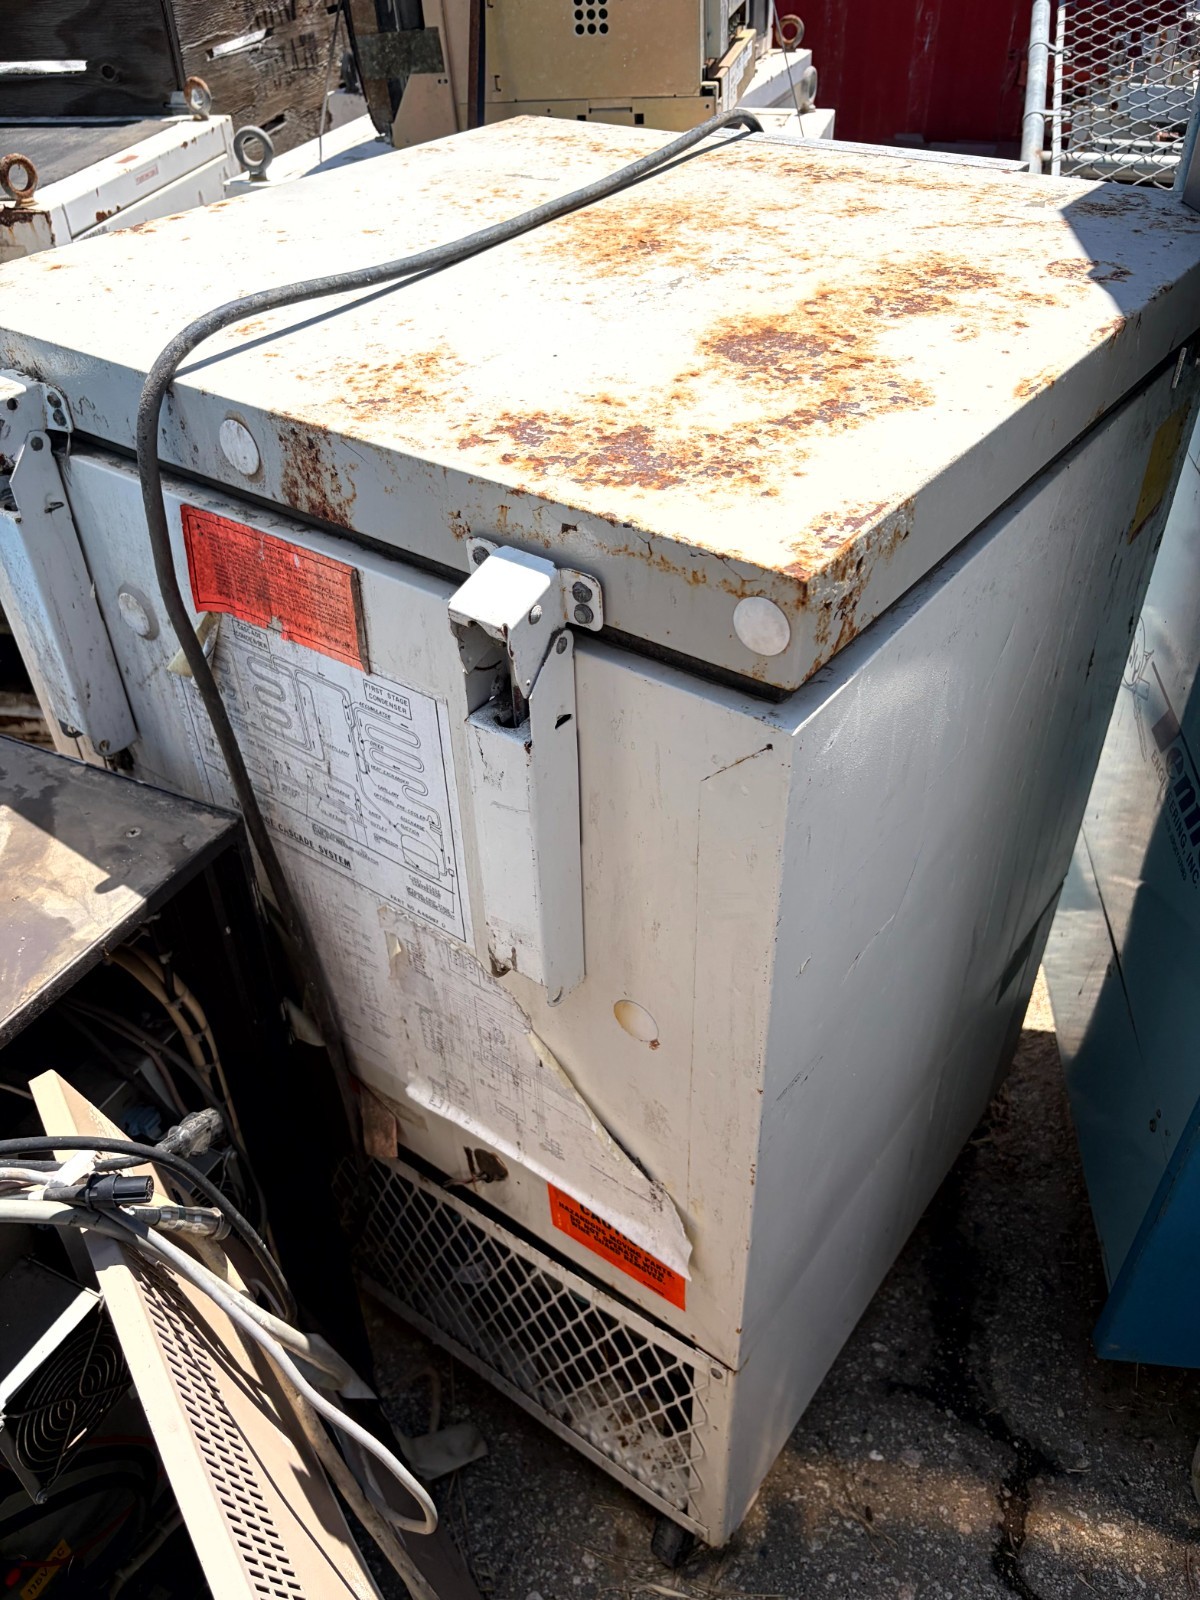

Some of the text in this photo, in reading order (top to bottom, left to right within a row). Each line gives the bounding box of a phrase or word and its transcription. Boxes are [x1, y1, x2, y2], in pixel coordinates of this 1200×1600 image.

[234, 631, 267, 649] CONDENSER
[364, 682, 408, 707] FIRST STAGE
[368, 692, 407, 715] CONDENSER
[359, 701, 391, 720] ACCUMULATOR
[278, 823, 315, 848] CASCADE
[318, 844, 351, 868] SYSTEM
[1185, 850, 1200, 889] INC.
[558, 1200, 606, 1236] HAZARDOUS
[609, 1233, 642, 1259] MOVING
[583, 1222, 598, 1237] NOT
[602, 1235, 639, 1262] OPERATE
[642, 1260, 665, 1279] WITH
[593, 1234, 621, 1256] GUARD
